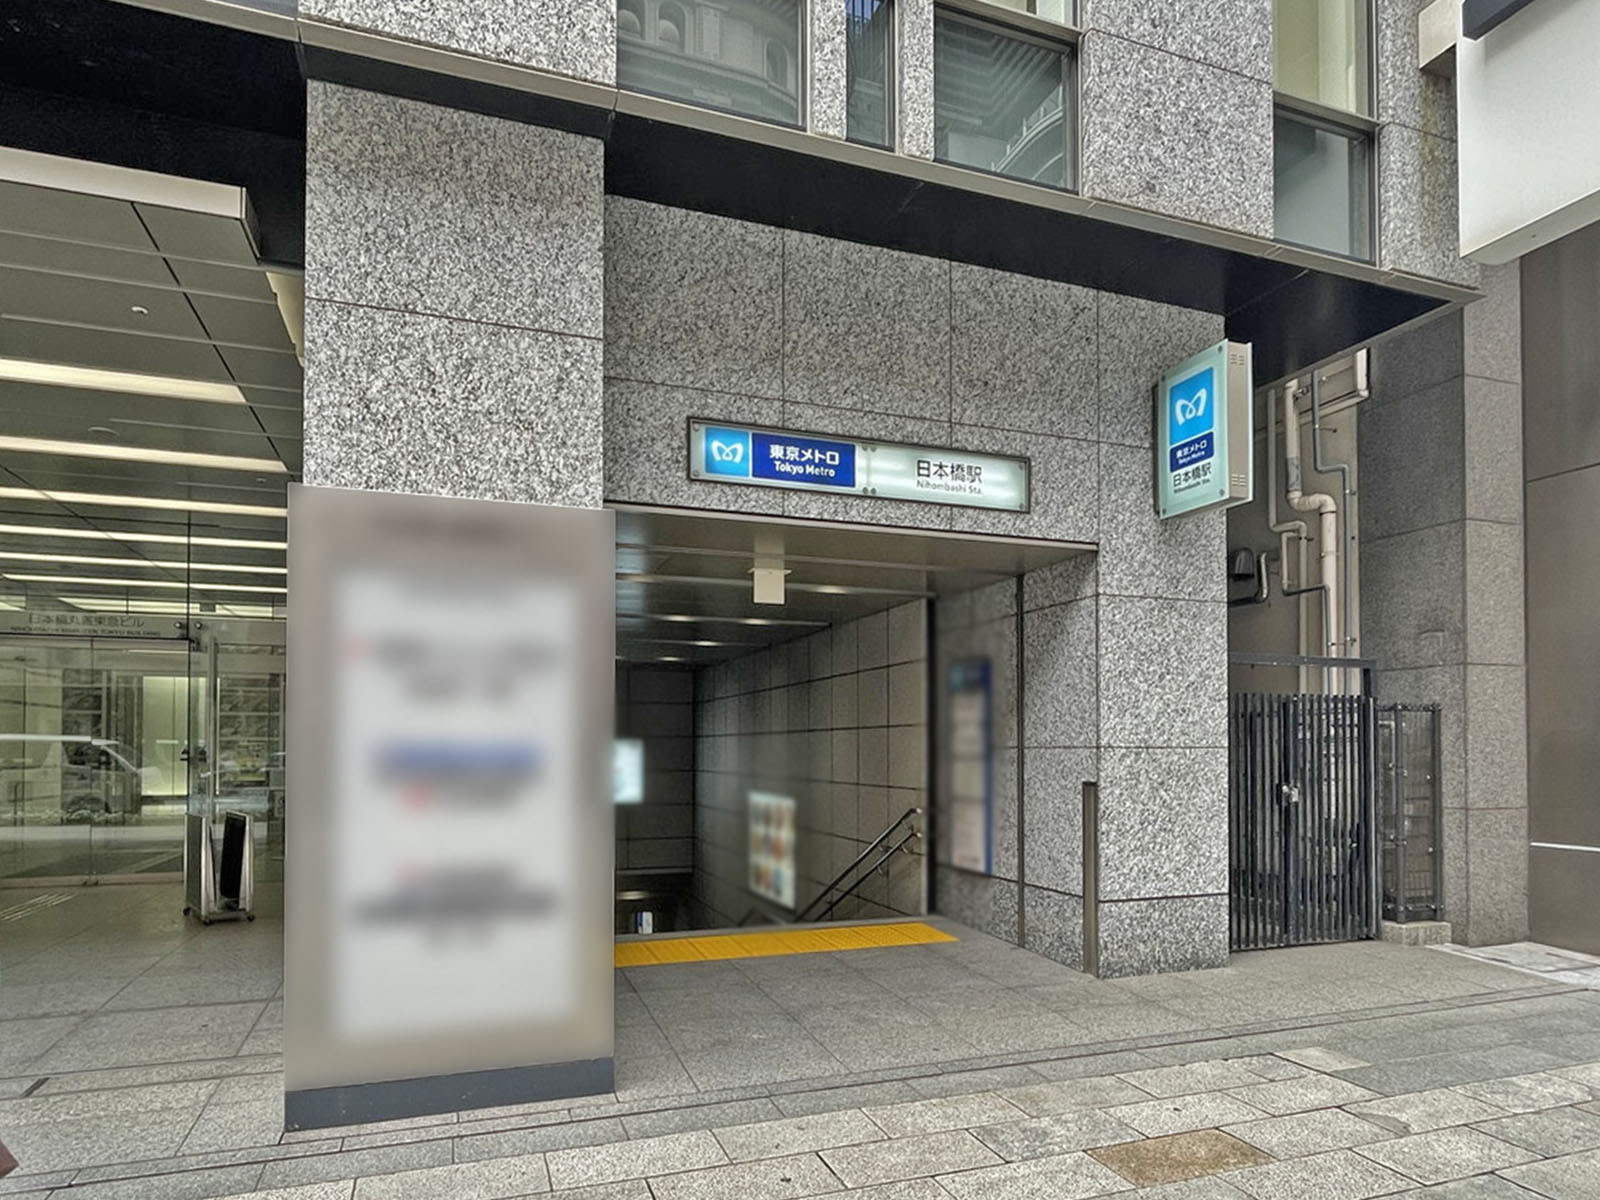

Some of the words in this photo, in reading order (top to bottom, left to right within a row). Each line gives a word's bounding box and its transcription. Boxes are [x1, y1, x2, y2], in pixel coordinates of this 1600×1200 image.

[769, 444, 840, 465] 東京メトロ
[1176, 440, 1207, 458] 東京メトロ
[774, 460, 804, 476] Tokyo
[805, 464, 836, 477] Metro
[917, 459, 983, 484] 日本橋駅
[1173, 462, 1212, 487] 日本橋駅
[916, 479, 967, 493] Nihombashi
